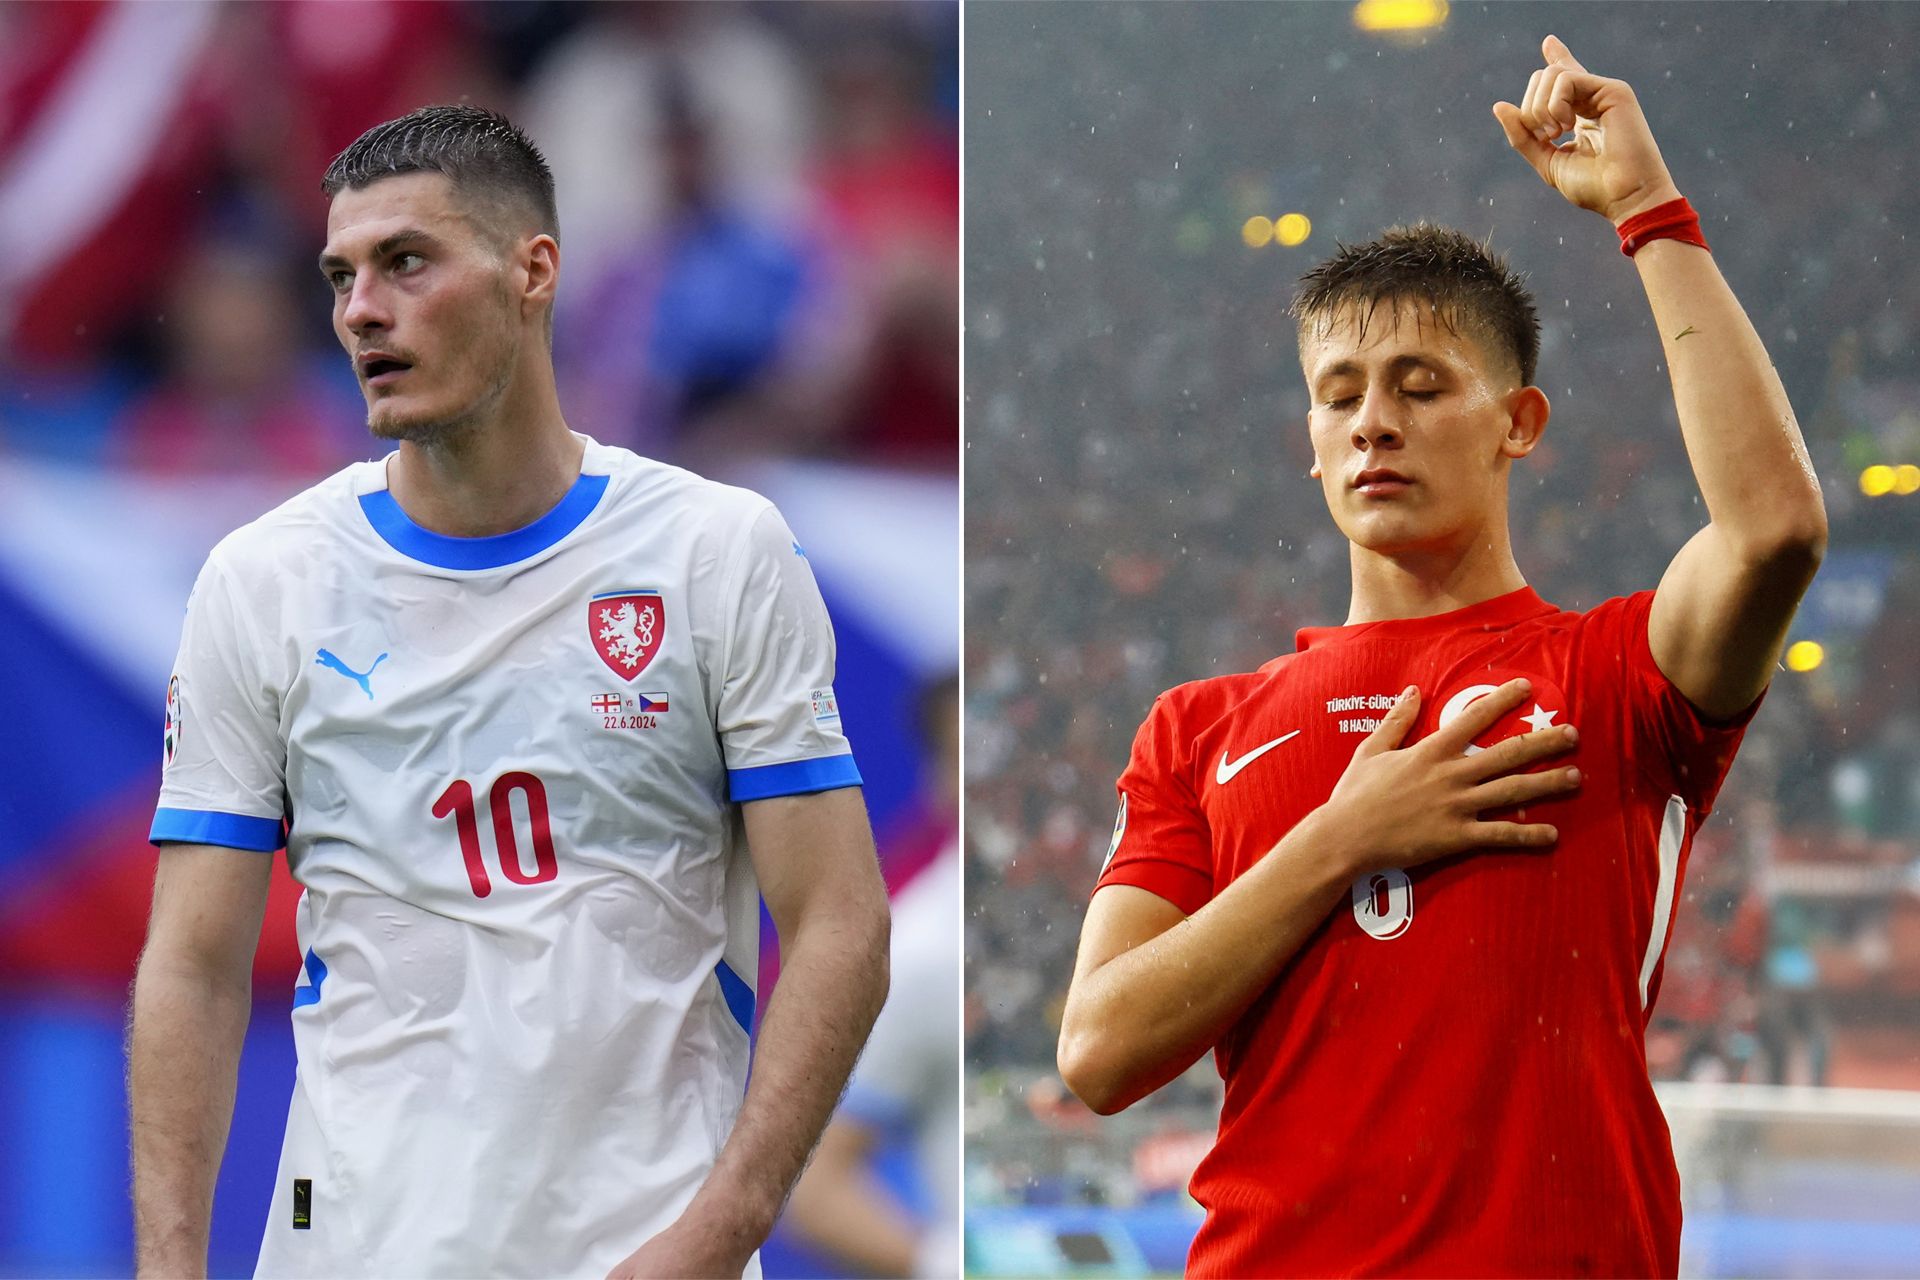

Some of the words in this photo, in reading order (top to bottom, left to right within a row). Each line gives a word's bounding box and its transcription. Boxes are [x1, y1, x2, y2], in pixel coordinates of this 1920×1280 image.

[604, 715, 656, 729] 22.6.2024
[1338, 719, 1349, 733] 18
[431, 771, 558, 898] 10
